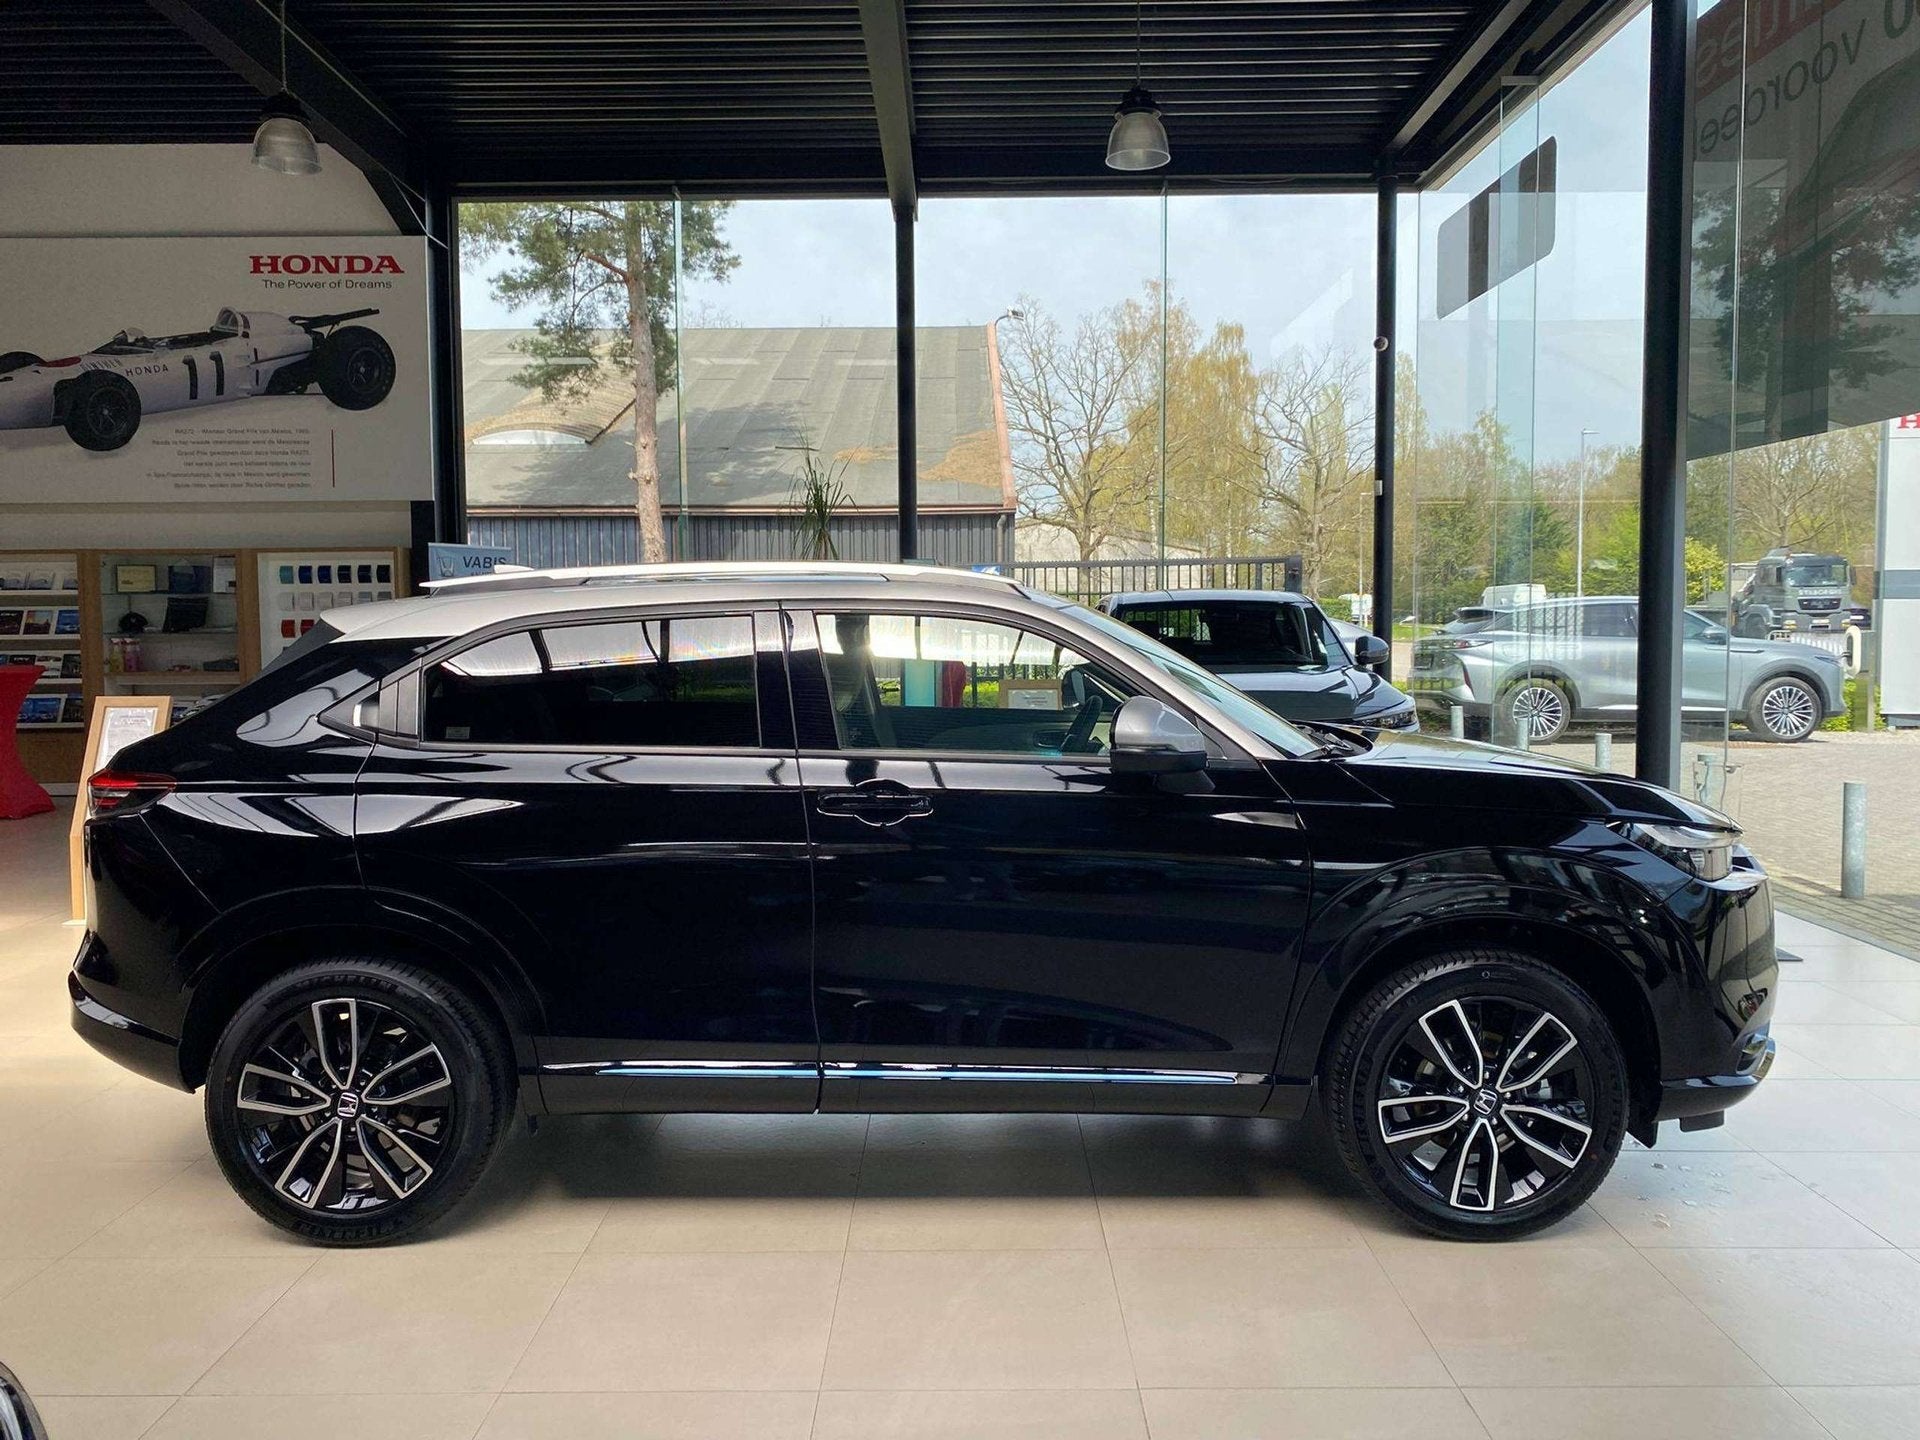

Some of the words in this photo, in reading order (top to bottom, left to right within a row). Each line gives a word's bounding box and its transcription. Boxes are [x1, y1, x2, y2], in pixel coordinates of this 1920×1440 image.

[249, 255, 405, 274] HONDA
[263, 279, 285, 289] The
[288, 279, 325, 289] Power
[329, 279, 342, 289] of
[345, 279, 393, 289] Dreams
[125, 364, 169, 377] HONDA
[182, 351, 225, 400] 11
[462, 556, 507, 569] VABIS
